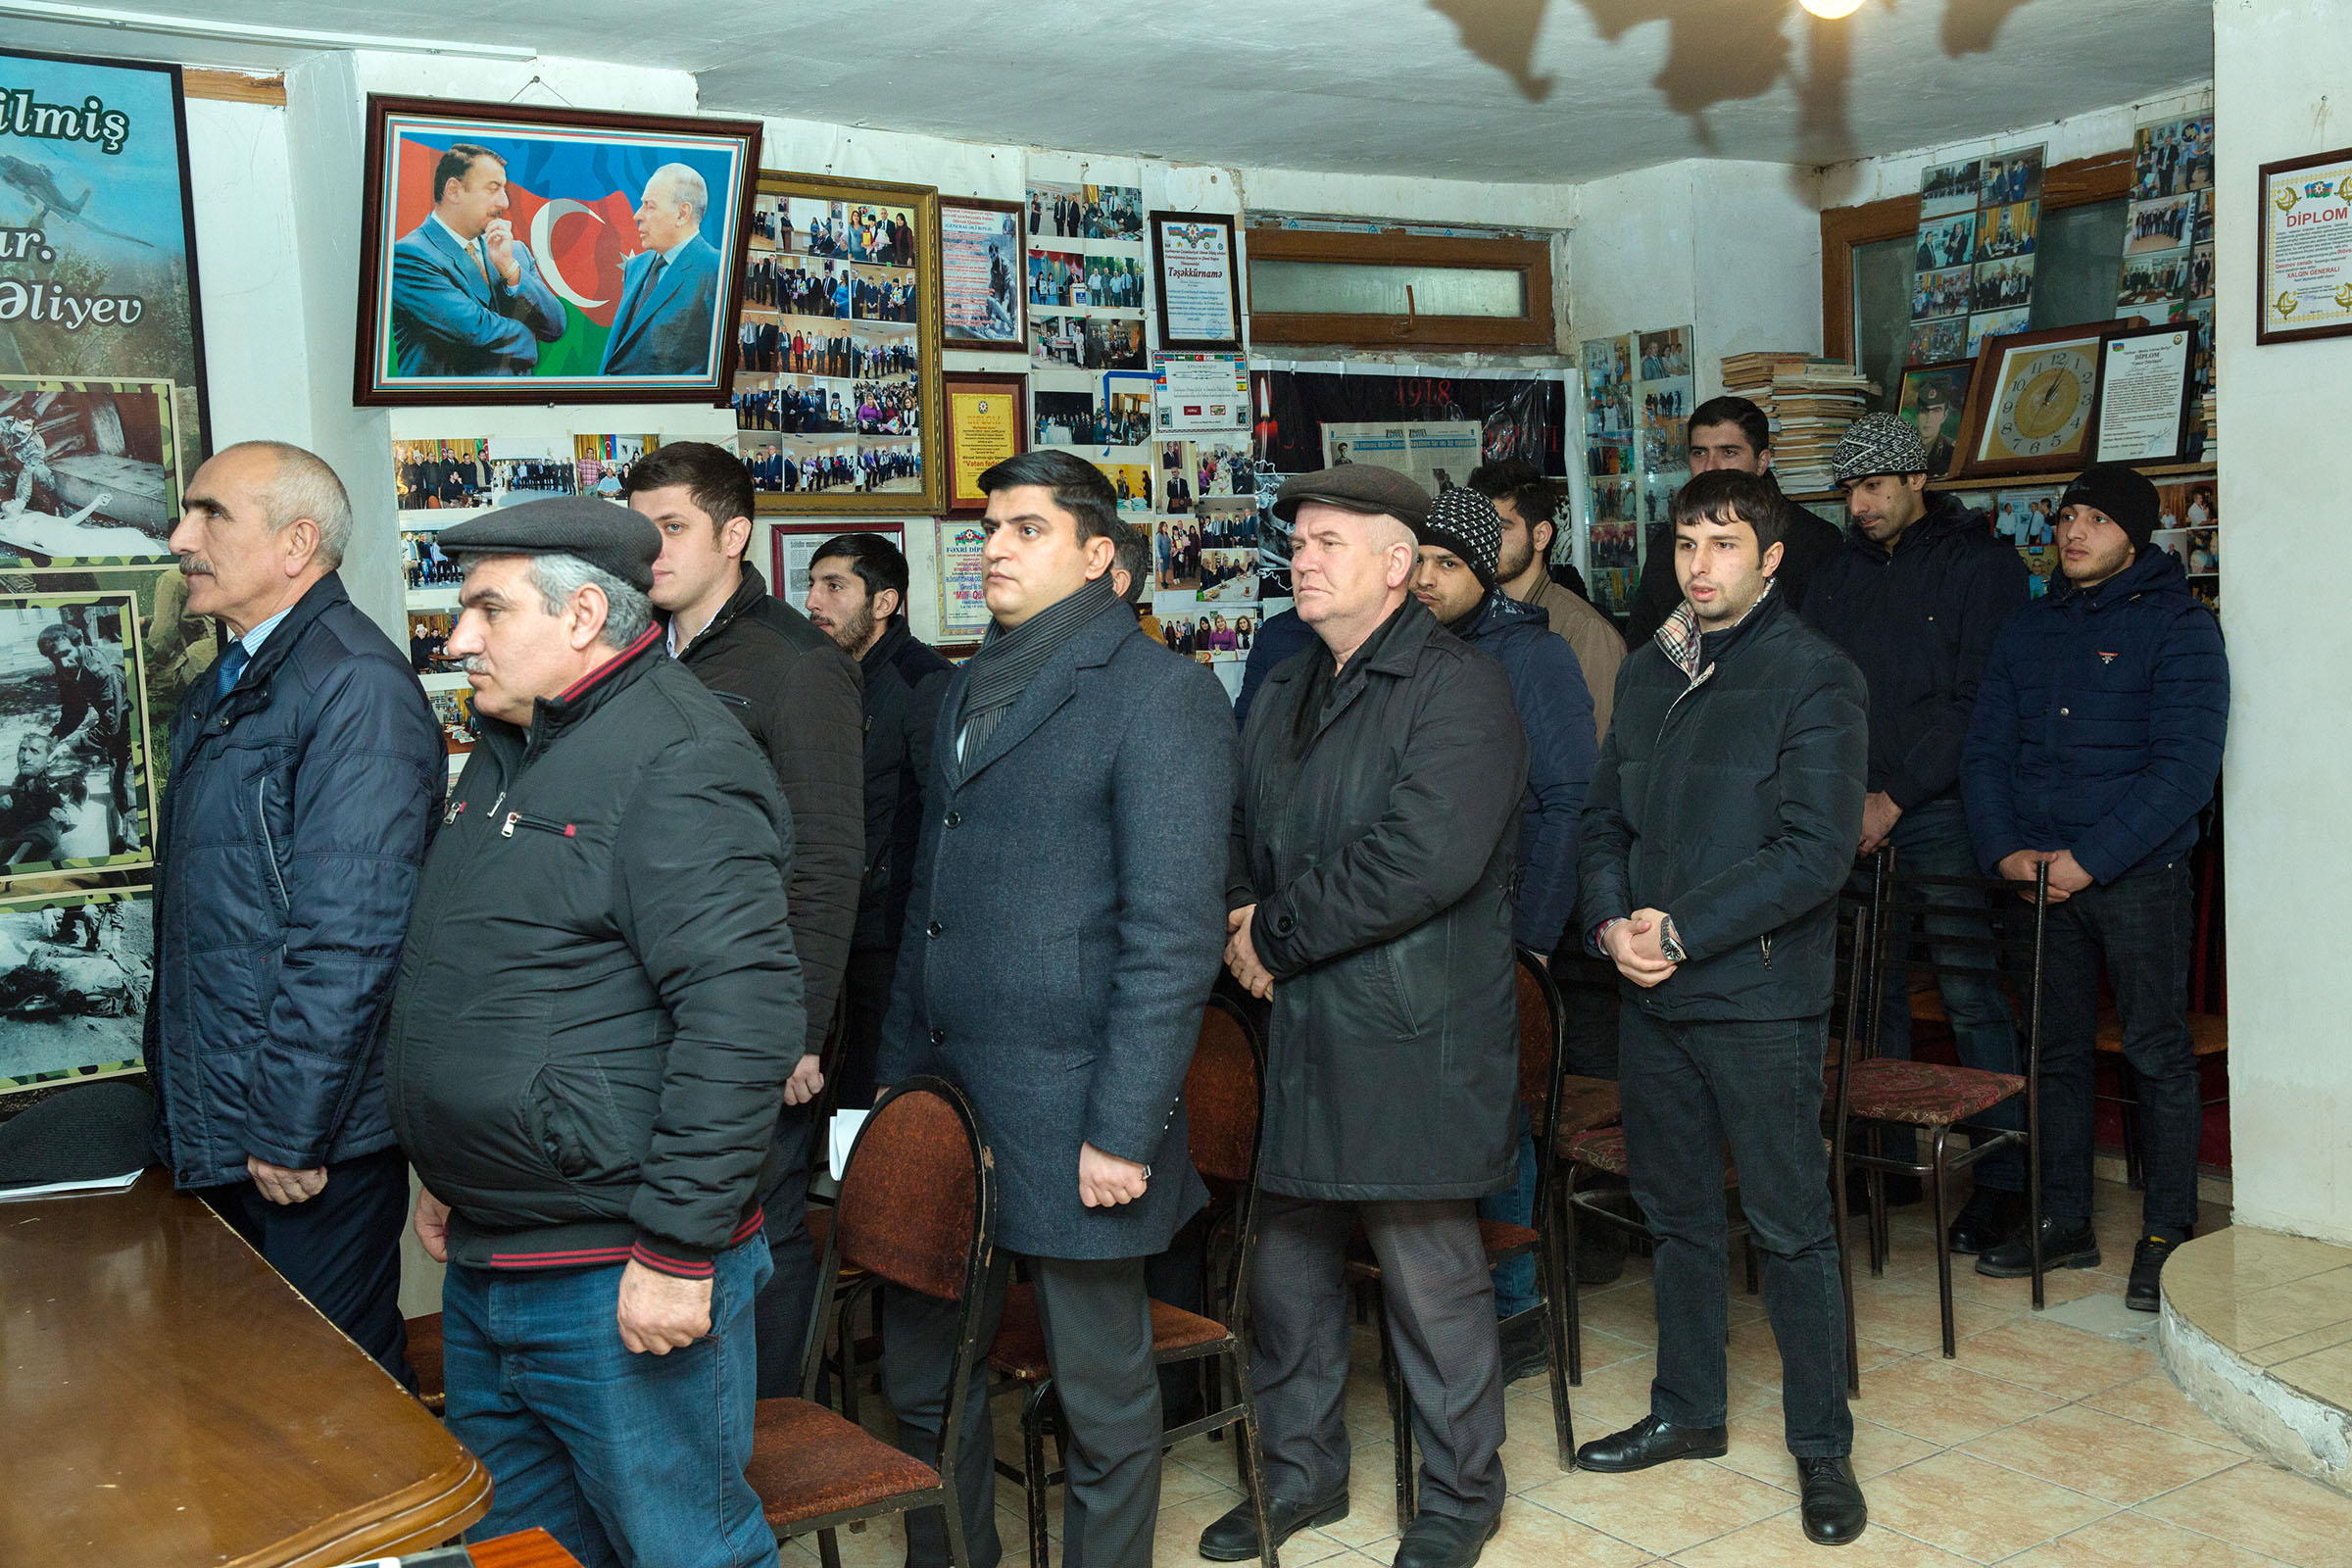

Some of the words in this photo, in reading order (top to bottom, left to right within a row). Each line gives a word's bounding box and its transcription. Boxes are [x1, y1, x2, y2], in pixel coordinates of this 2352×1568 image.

[2286, 207, 2348, 227] DİPLOM
[0, 281, 142, 329] Əliyev
[2051, 353, 2067, 366] 12
[2075, 358, 2081, 368] 1
[2032, 363, 2042, 374] 11
[2082, 371, 2093, 384] 2
[2012, 379, 2026, 392] 10
[1396, 378, 1452, 408] 1918
[2081, 393, 2093, 406] 3
[2002, 401, 2013, 414] 9
[2001, 422, 2013, 435] 8
[2069, 417, 2081, 428] 4
[2013, 438, 2023, 450] 7
[2050, 435, 2061, 447] 5
[2030, 442, 2040, 455] 6
